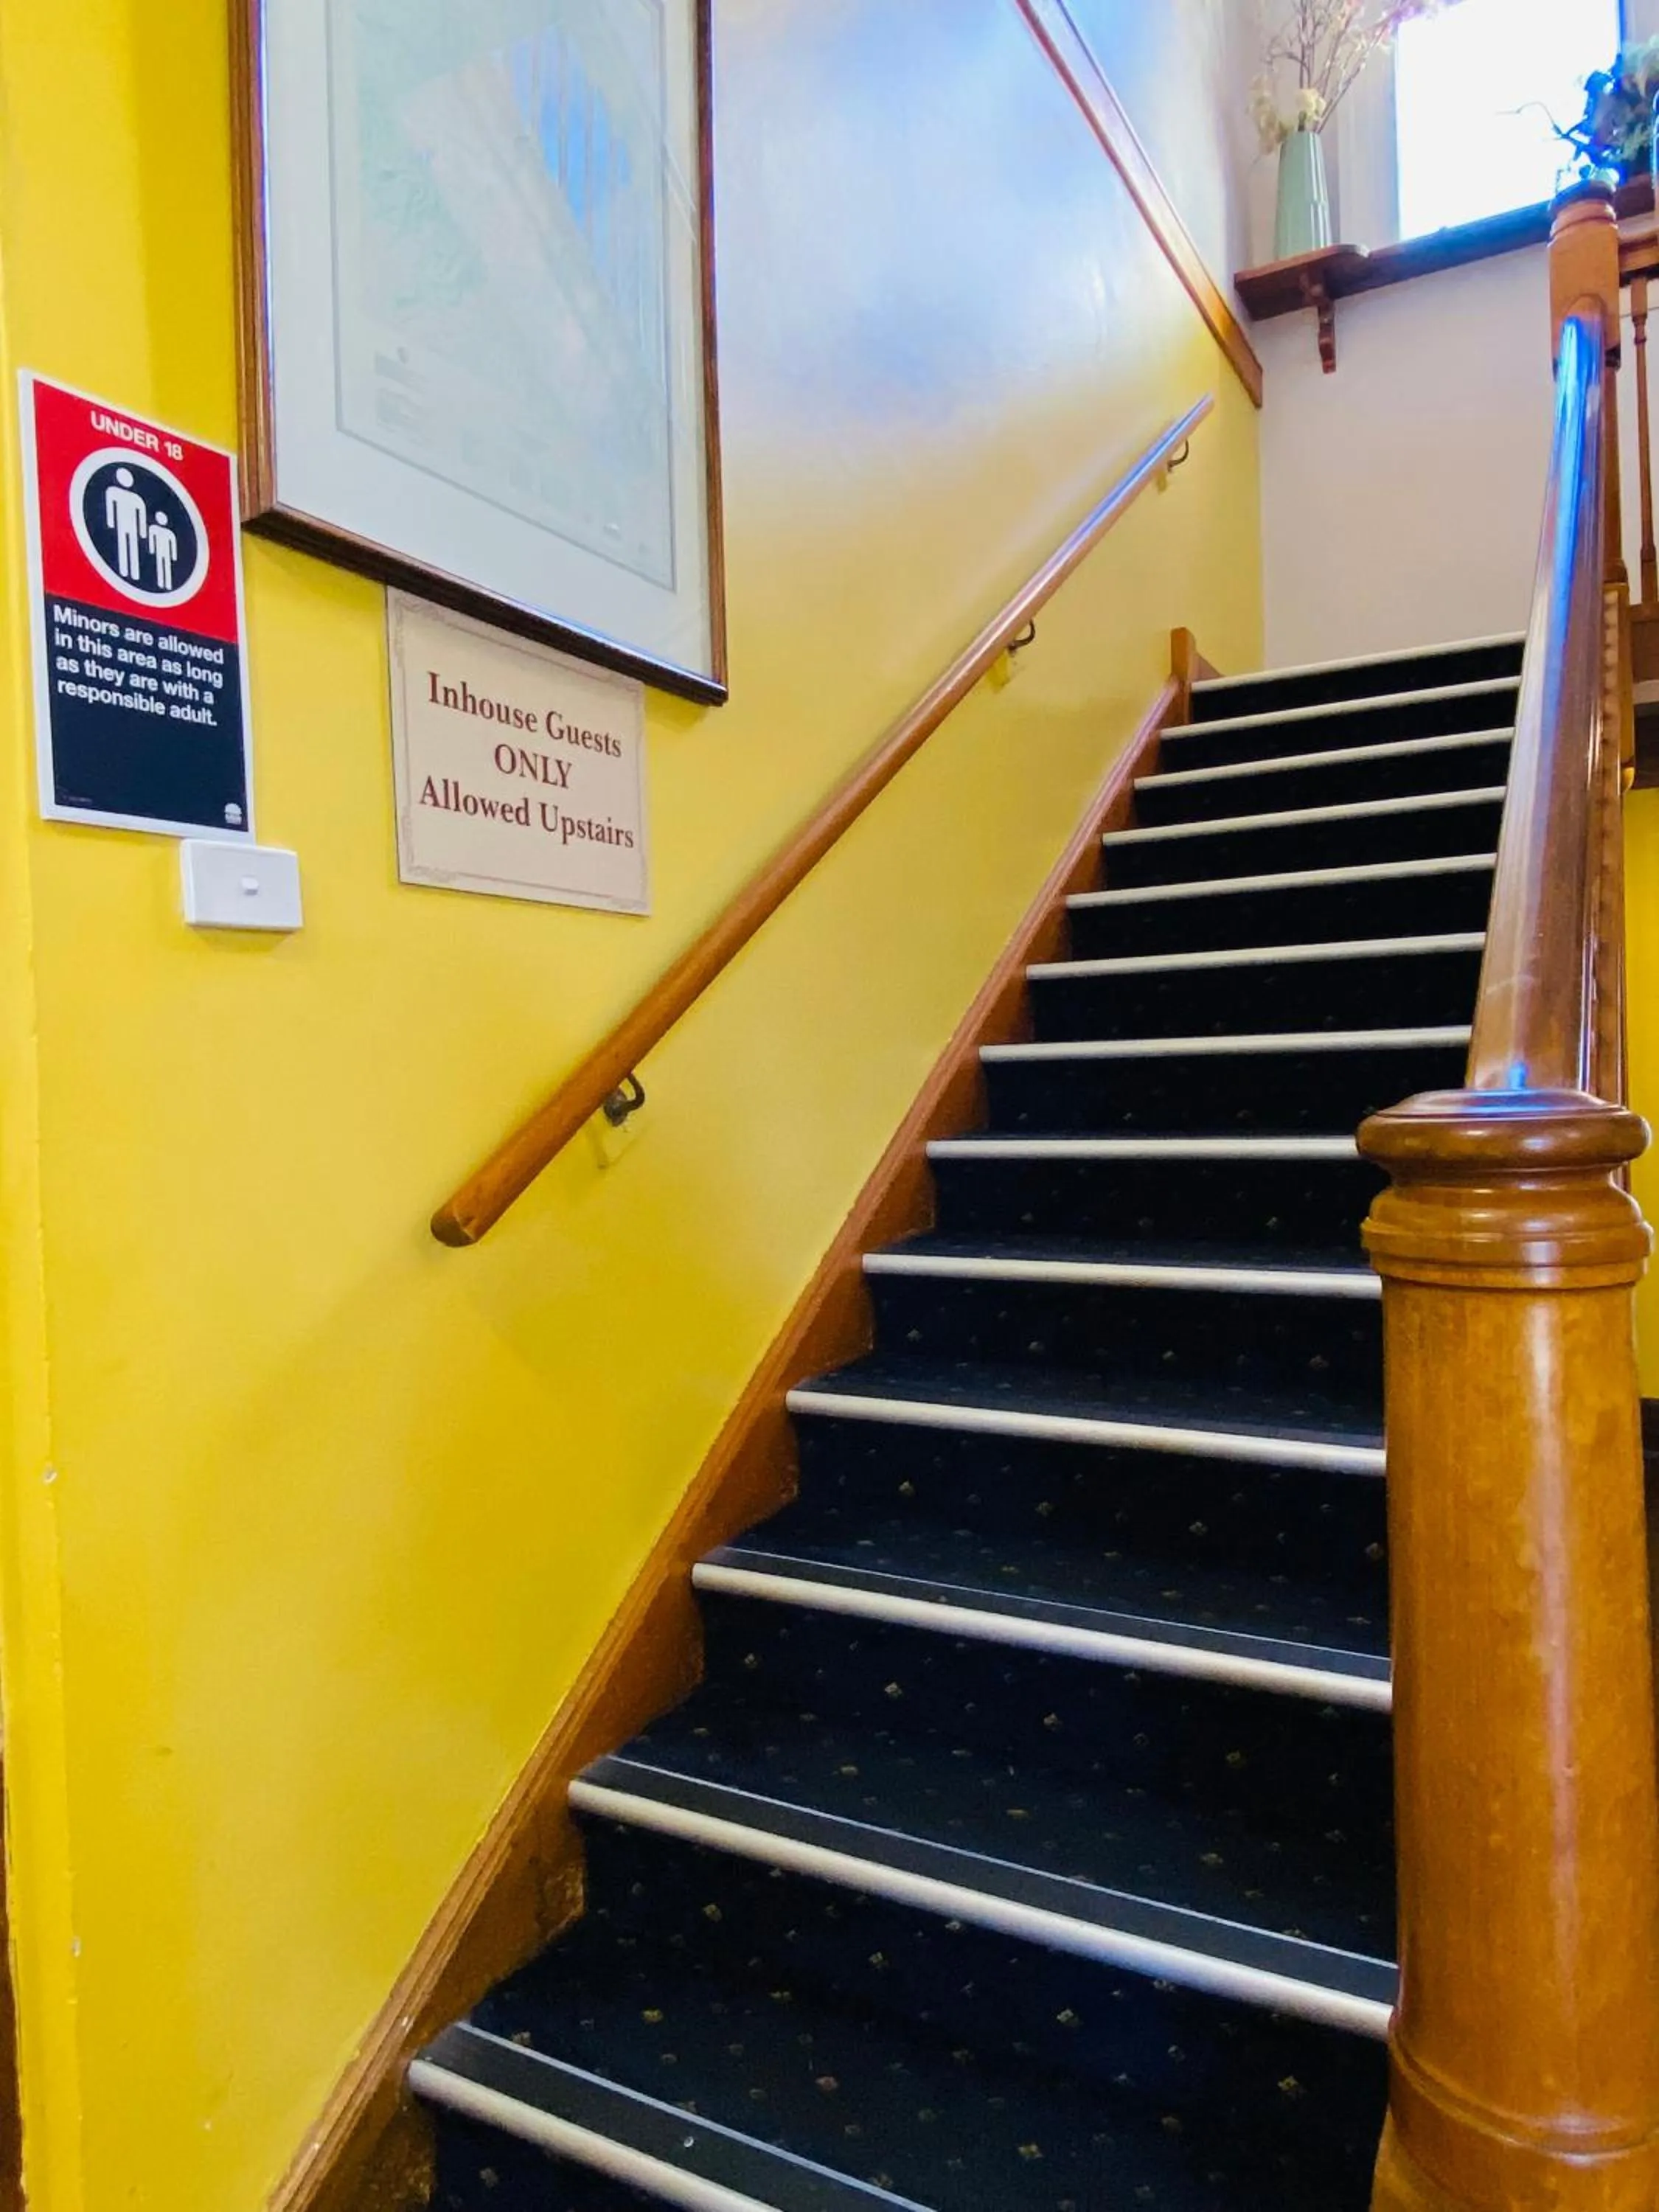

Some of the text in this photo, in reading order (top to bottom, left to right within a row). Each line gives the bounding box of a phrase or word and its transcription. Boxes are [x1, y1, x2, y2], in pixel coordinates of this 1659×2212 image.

[91, 411, 184, 461] UNDER 18
[53, 605, 223, 664] Minors are allowed
[55, 629, 223, 689] in this area as long
[56, 655, 214, 705] as they are with a
[58, 679, 218, 726] responsible adult.
[427, 671, 622, 757] Inhouse Guests
[495, 744, 572, 789] ONLY
[420, 775, 633, 848] Allowed Upstairs
